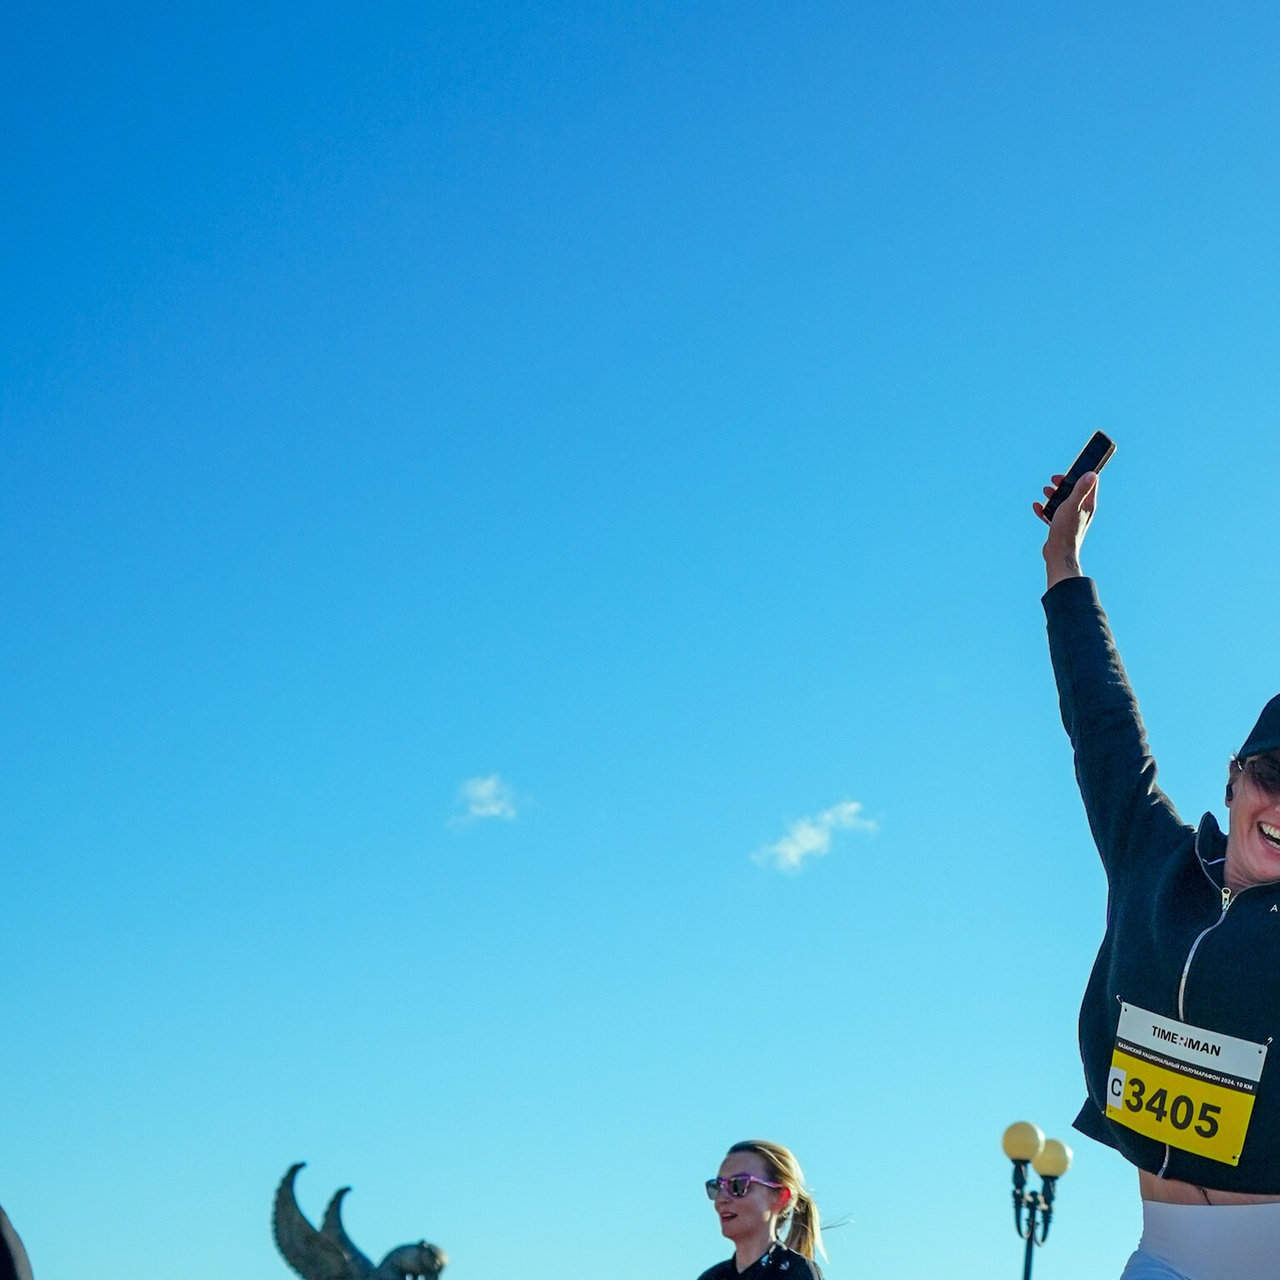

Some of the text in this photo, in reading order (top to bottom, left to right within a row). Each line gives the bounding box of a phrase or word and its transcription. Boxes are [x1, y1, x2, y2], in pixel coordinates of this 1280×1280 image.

[1117, 1041, 1142, 1056] КАЗАНСКИЙ
[1142, 1051, 1180, 1070] НАЦИОНАЛЬНЫЙ
[1180, 1065, 1221, 1082] ПОЛУМАРАФОН
[1111, 1078, 1221, 1138] C 3405
